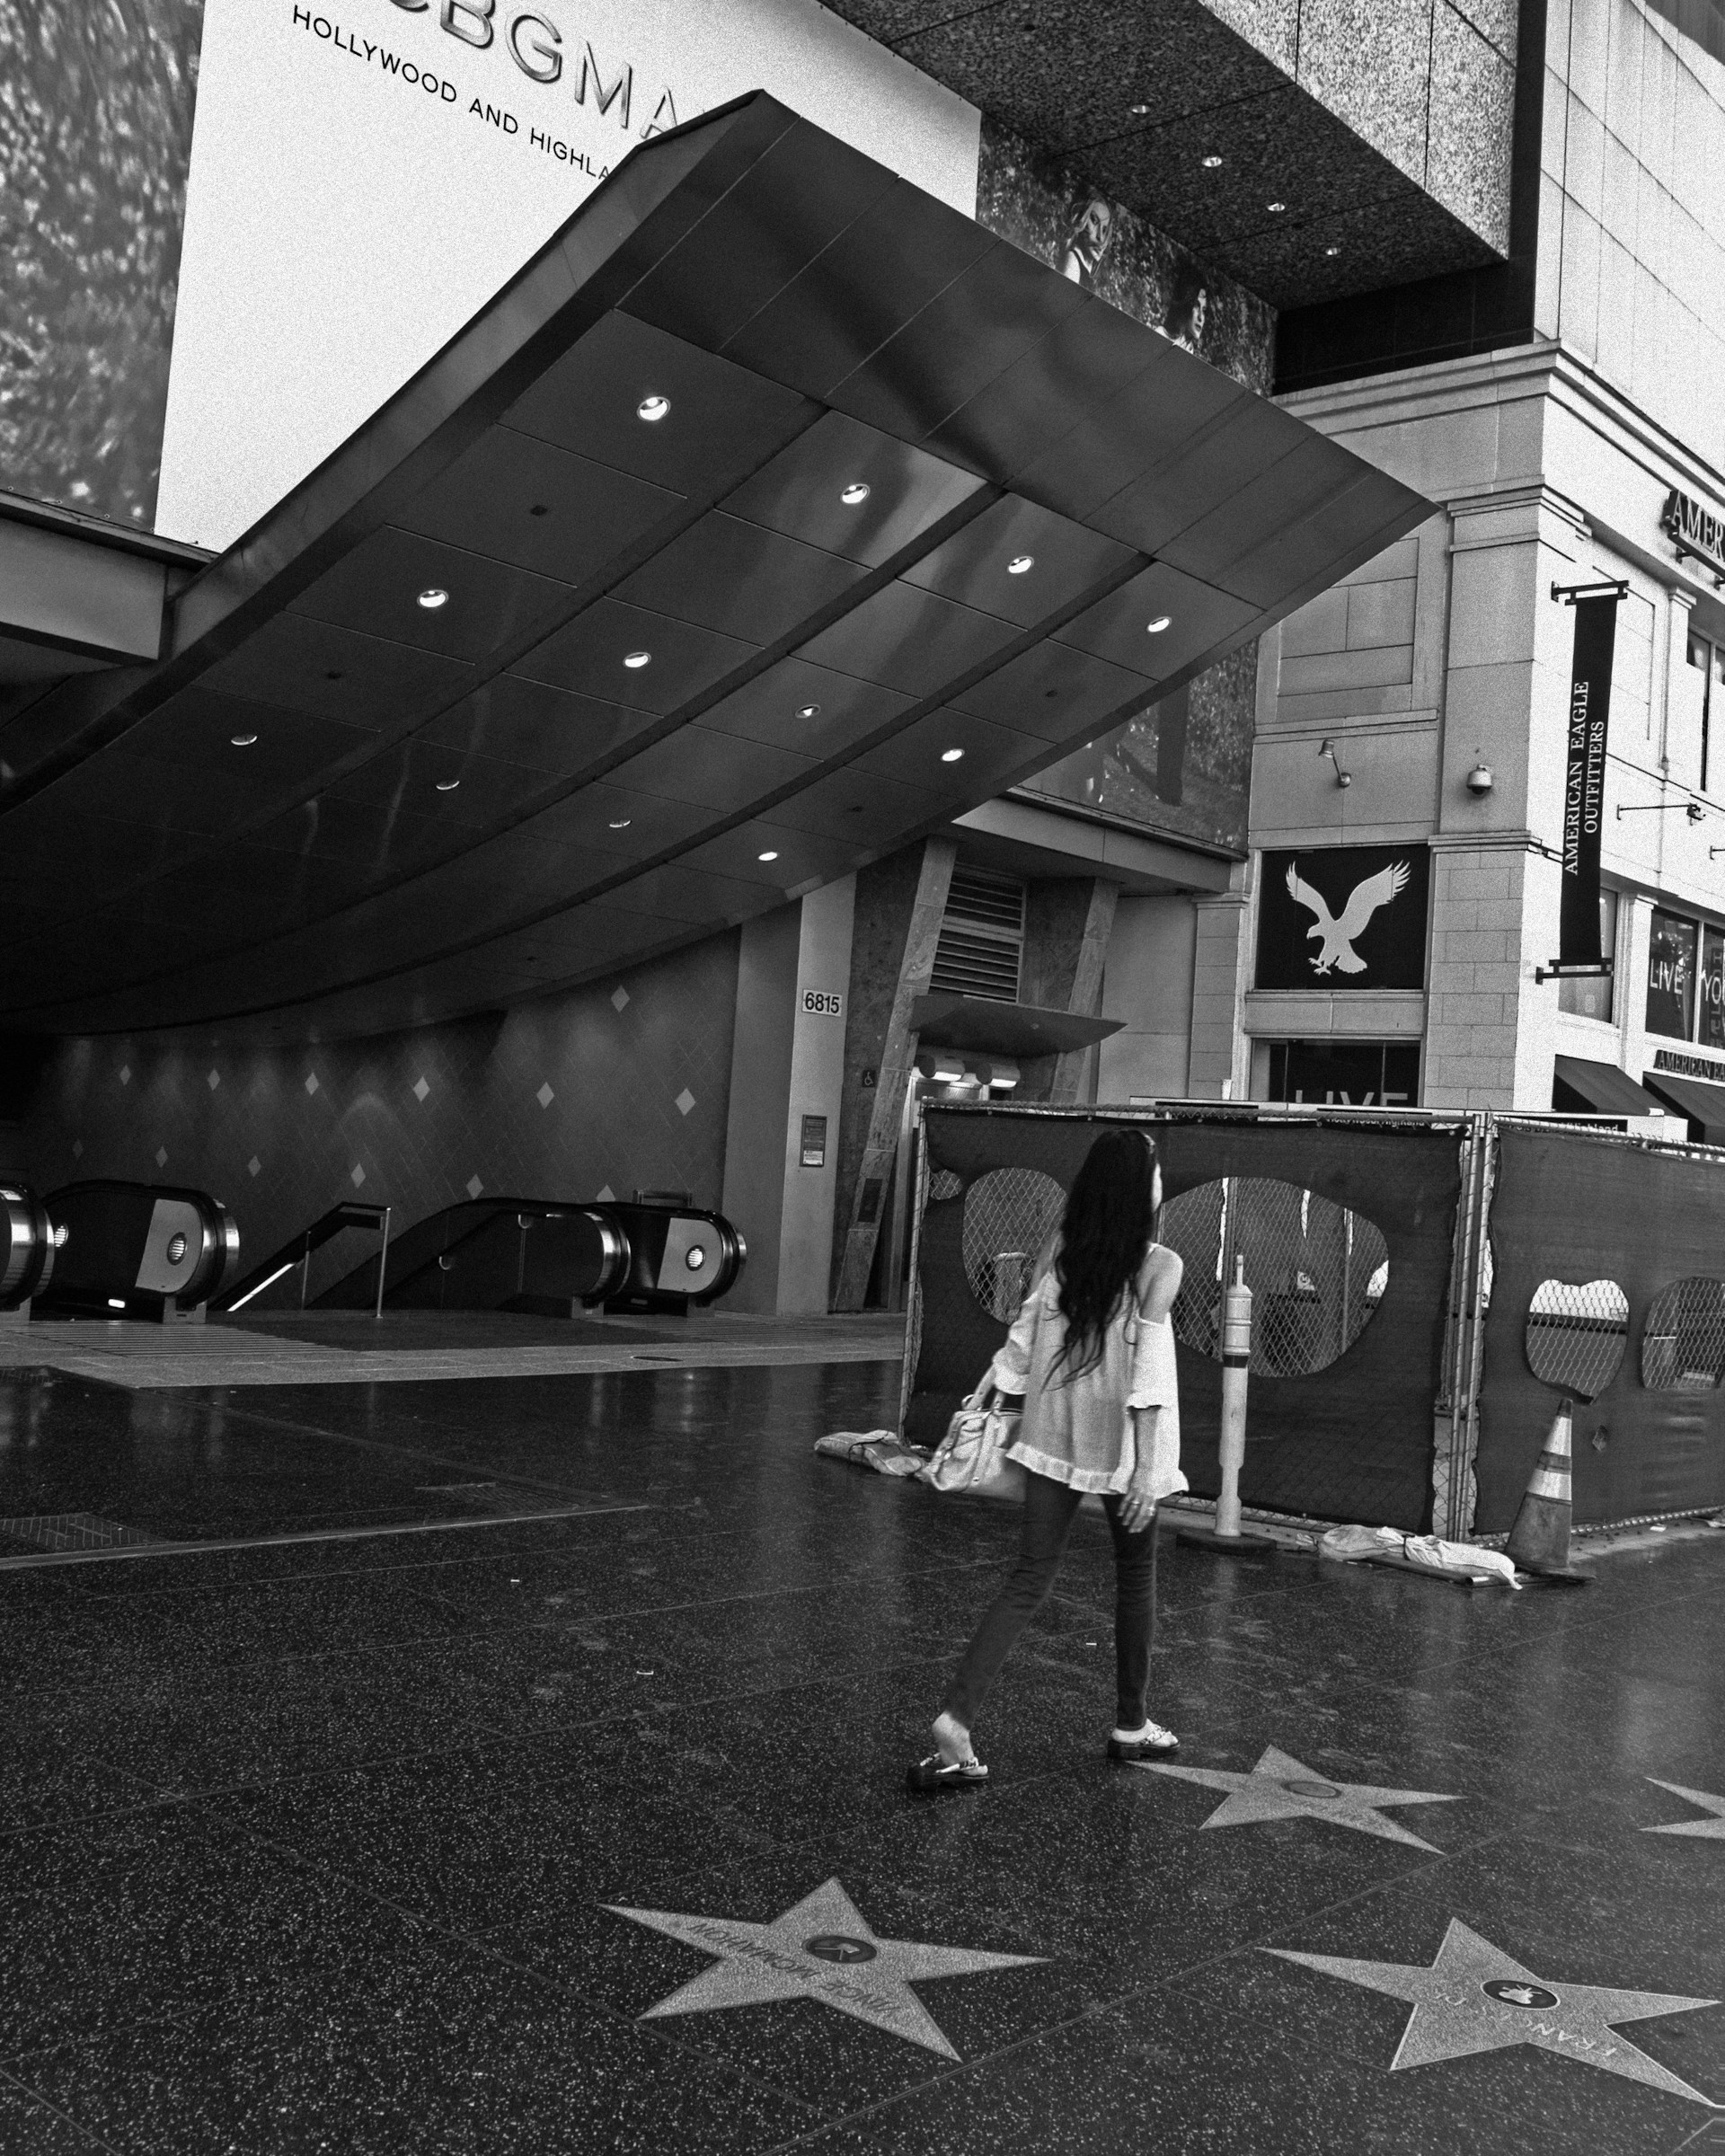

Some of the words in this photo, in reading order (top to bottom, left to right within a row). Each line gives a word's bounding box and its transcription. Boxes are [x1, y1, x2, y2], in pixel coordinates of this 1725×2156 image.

[292, 4, 457, 103] HOLLYWOOD
[469, 98, 518, 135] AND
[1570, 681, 1589, 751] EAGLE
[1584, 720, 1605, 834] OUTFITTERS
[1565, 761, 1584, 876] AMERICAN
[804, 992, 840, 1014] 6815
[1650, 958, 1684, 995] LIVE
[1658, 1049, 1712, 1080] AMERICAN
